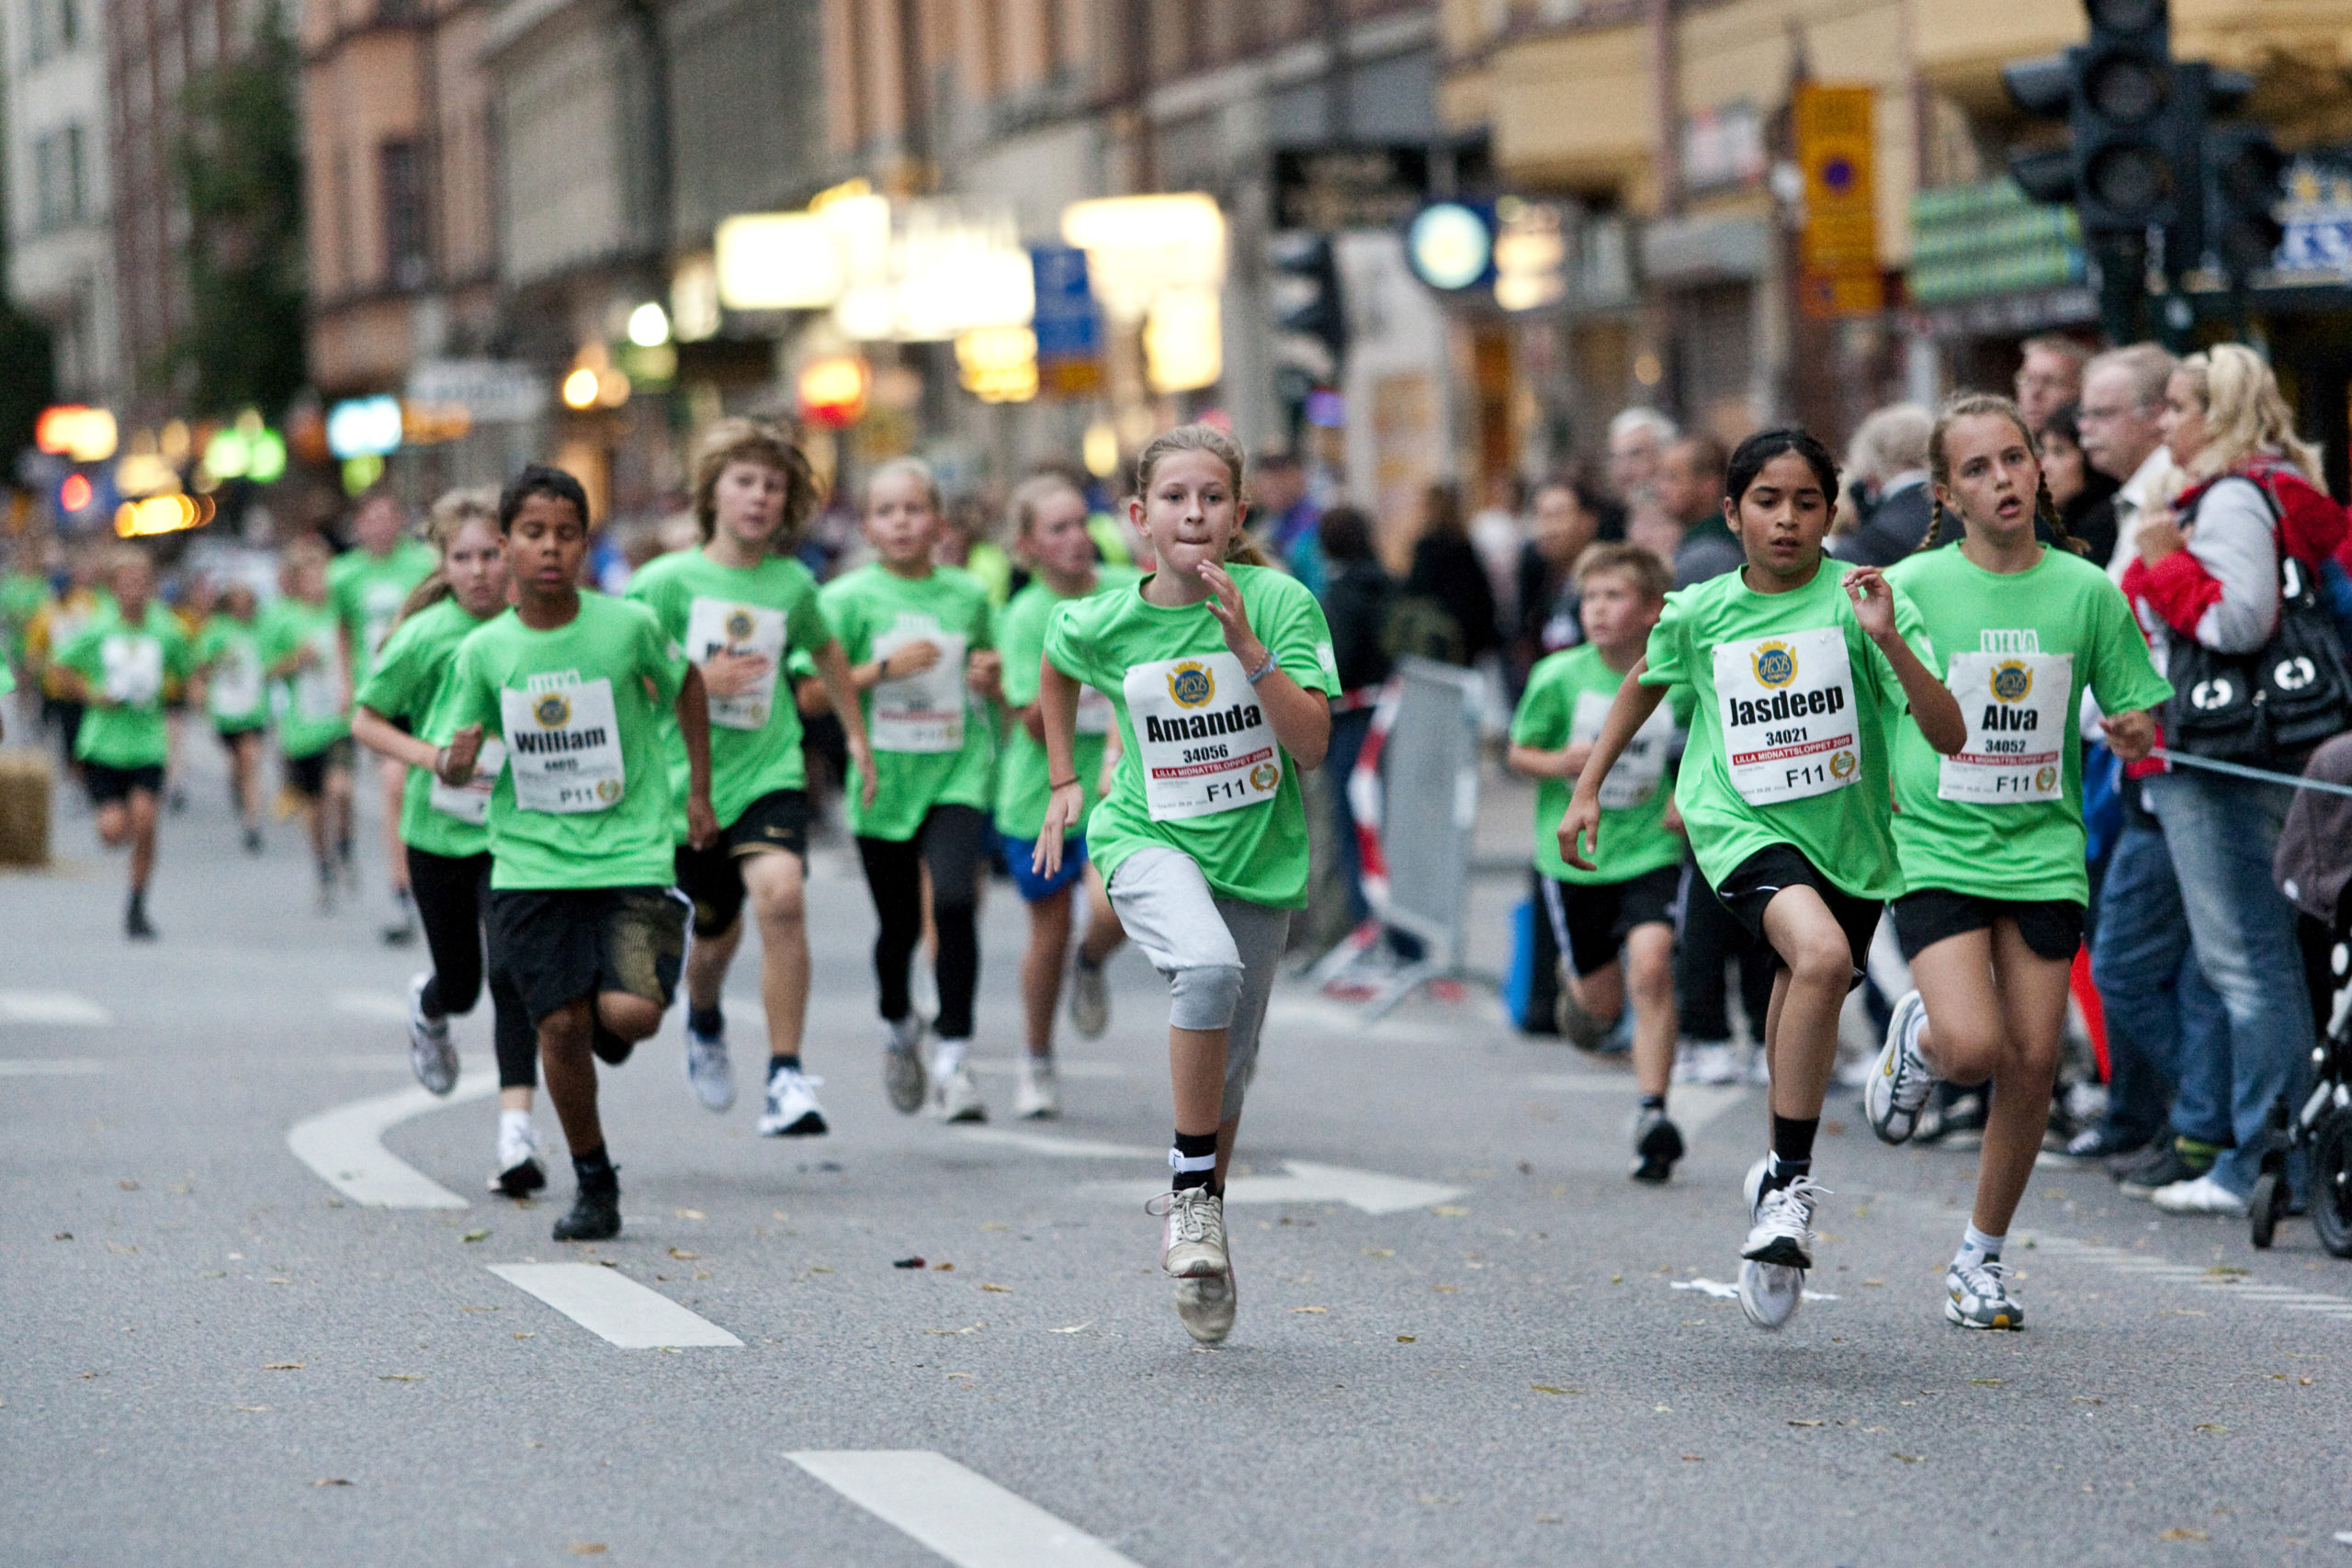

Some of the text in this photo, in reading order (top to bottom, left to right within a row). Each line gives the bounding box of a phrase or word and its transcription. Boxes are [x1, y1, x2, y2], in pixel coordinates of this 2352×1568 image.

[1760, 654, 1790, 675] HSB
[1730, 685, 1845, 727] Jasdeep
[1146, 704, 1262, 742] Amanda
[1982, 705, 2038, 730] Alva
[514, 727, 606, 753] William
[1765, 728, 1807, 746] 34021
[1985, 739, 2026, 753] 34052
[1182, 744, 1228, 763] 34056
[1735, 754, 1757, 764] LILLA
[1758, 741, 1831, 761] MIDNATTSLOPPET
[1155, 769, 1177, 778] LILLA
[1178, 756, 1250, 777] MIDNATTSLOPPET
[1786, 764, 1824, 788] F11
[1206, 779, 1245, 802] F11
[1996, 775, 2030, 792] F11
[560, 788, 594, 804] P11
